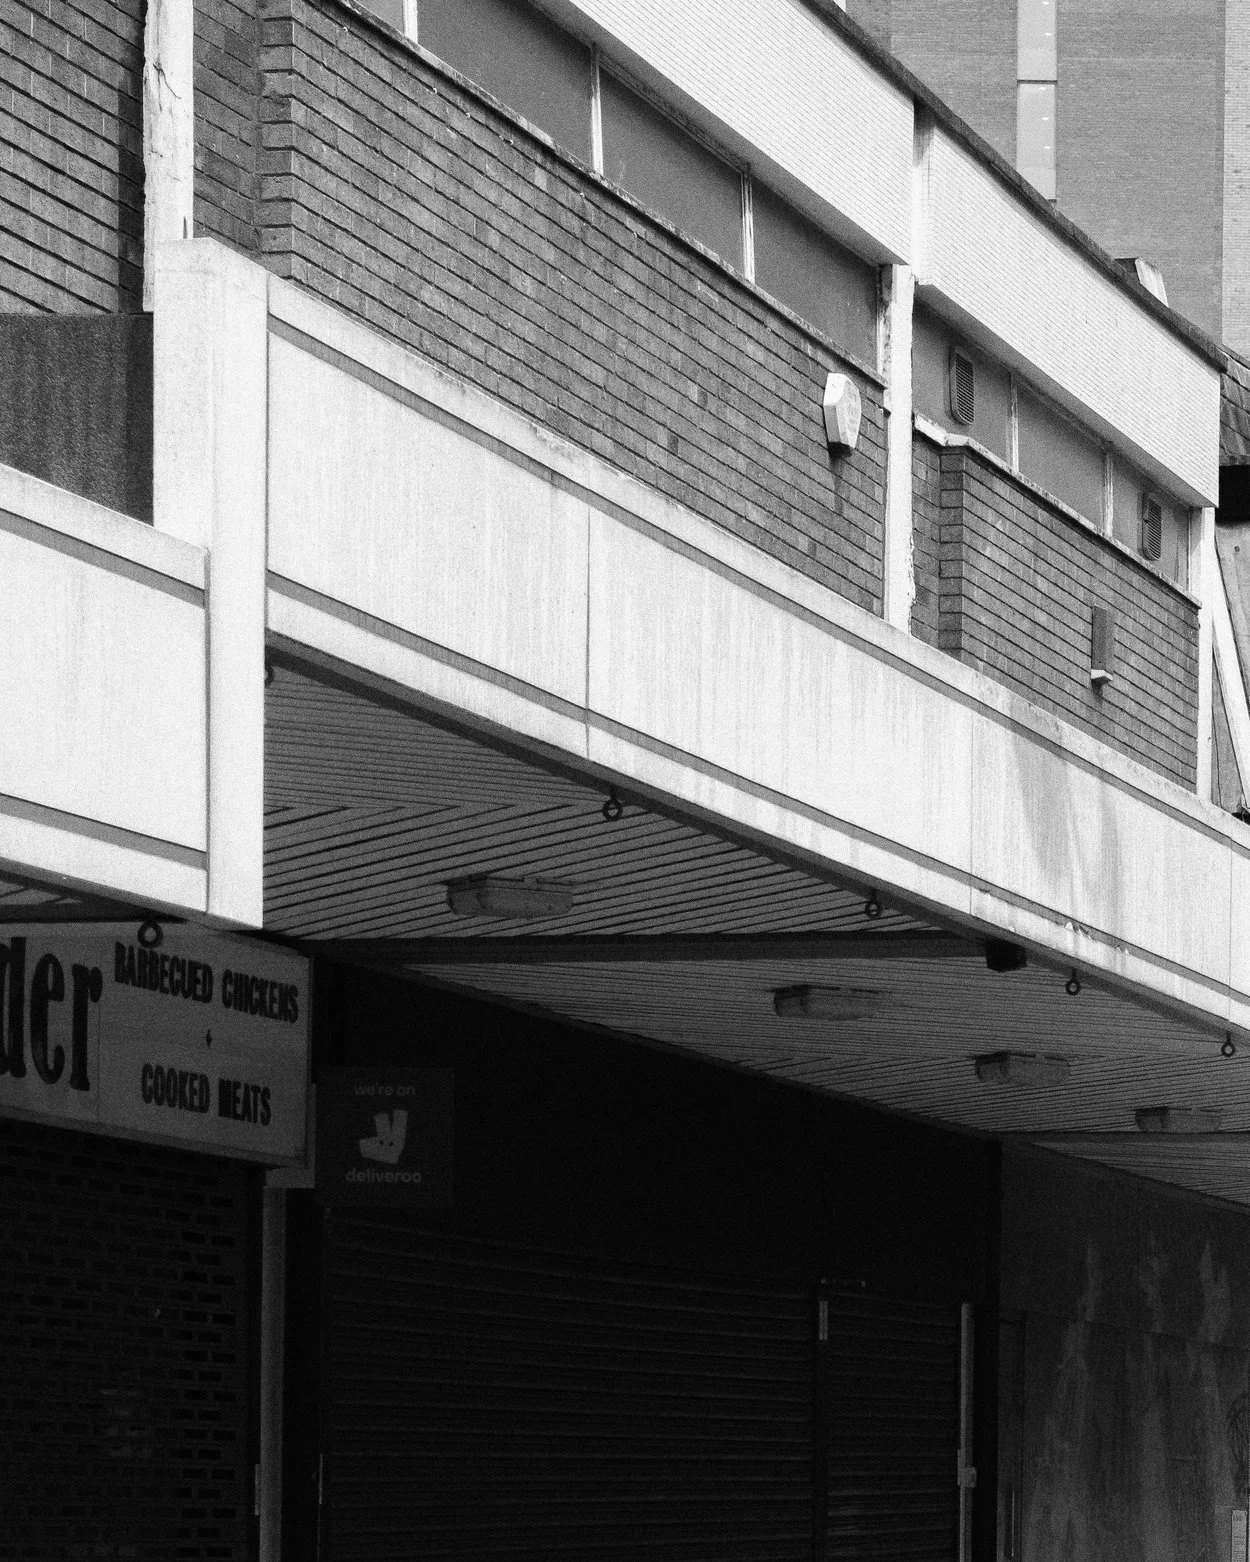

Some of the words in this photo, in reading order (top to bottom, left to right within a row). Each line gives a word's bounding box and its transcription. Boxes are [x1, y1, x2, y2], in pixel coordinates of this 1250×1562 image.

[114, 942, 213, 1004] BARBECUED
[222, 969, 299, 1023] CHICKENS
[141, 1063, 210, 1114] COOKED
[219, 1078, 271, 1126] MEATS
[396, 1086, 416, 1096] on
[345, 1168, 422, 1183] deliveroo
